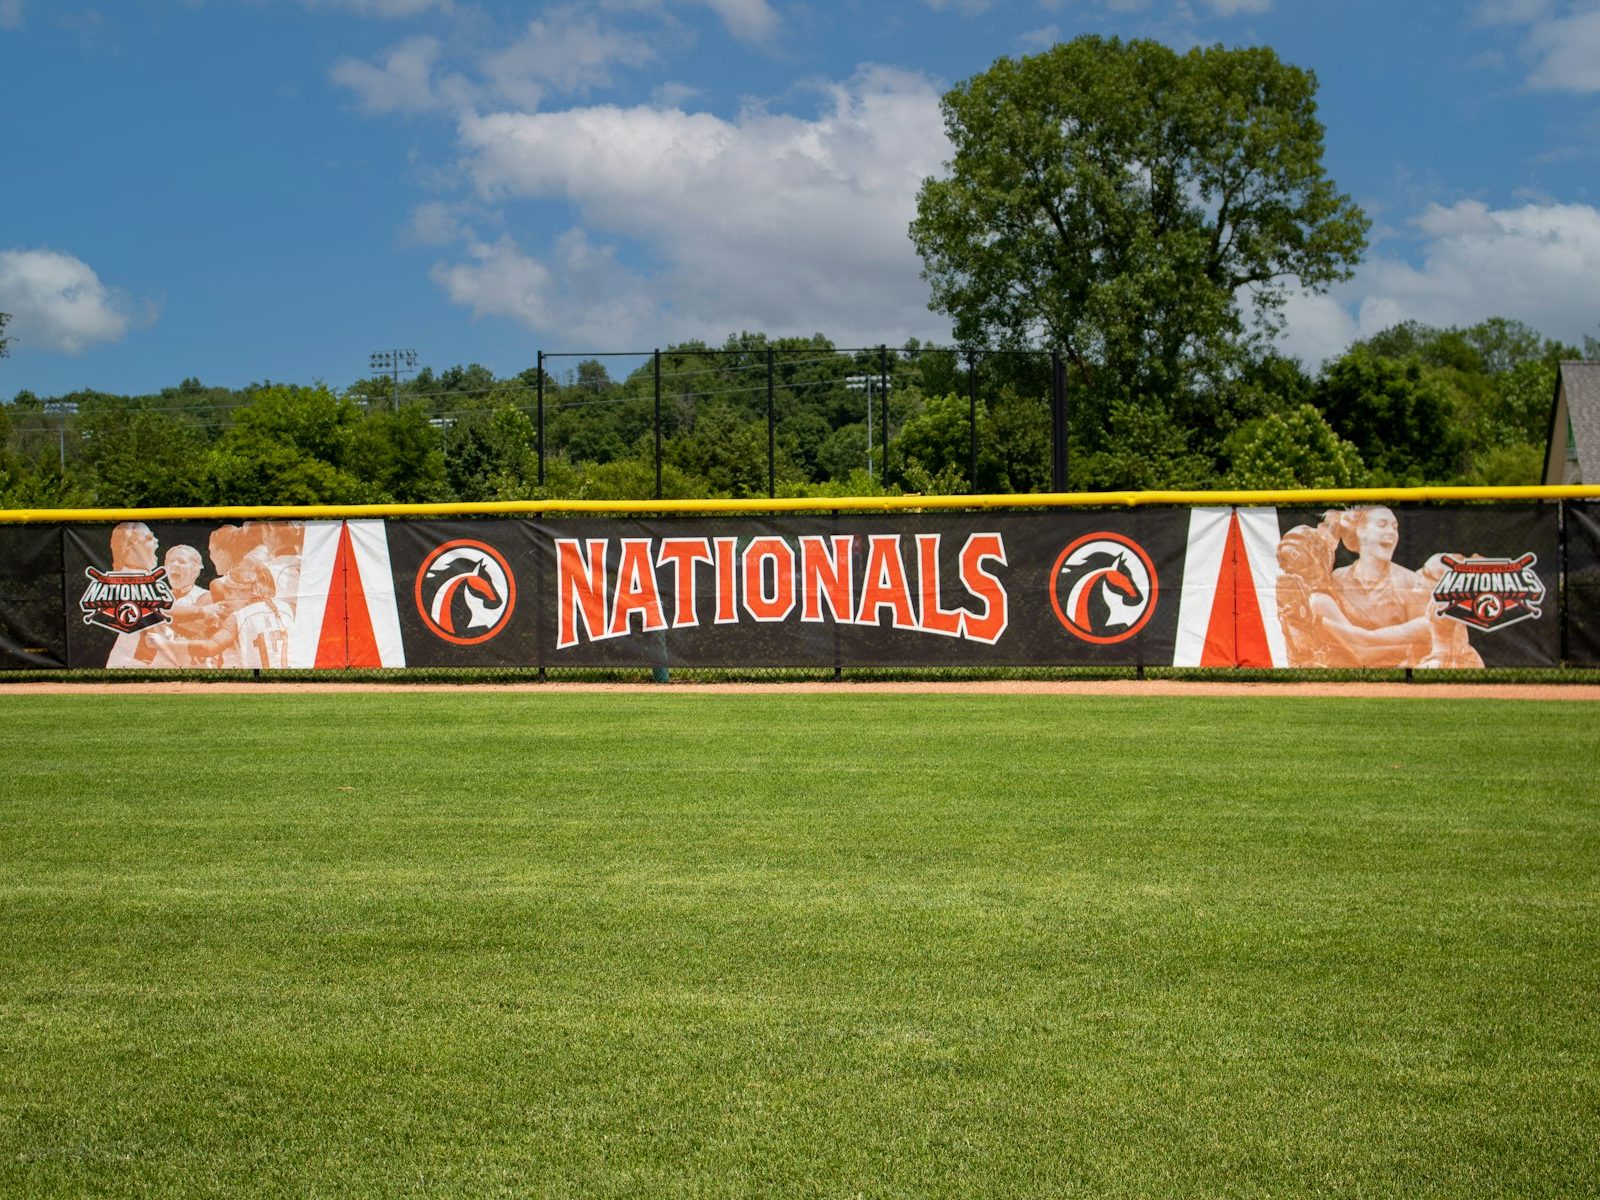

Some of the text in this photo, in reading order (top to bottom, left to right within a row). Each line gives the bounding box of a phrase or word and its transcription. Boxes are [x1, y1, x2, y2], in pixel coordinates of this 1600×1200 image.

[83, 581, 173, 602] NATIONALS
[554, 532, 1008, 650] NATIONALS
[1436, 570, 1542, 594] NATIONALS
